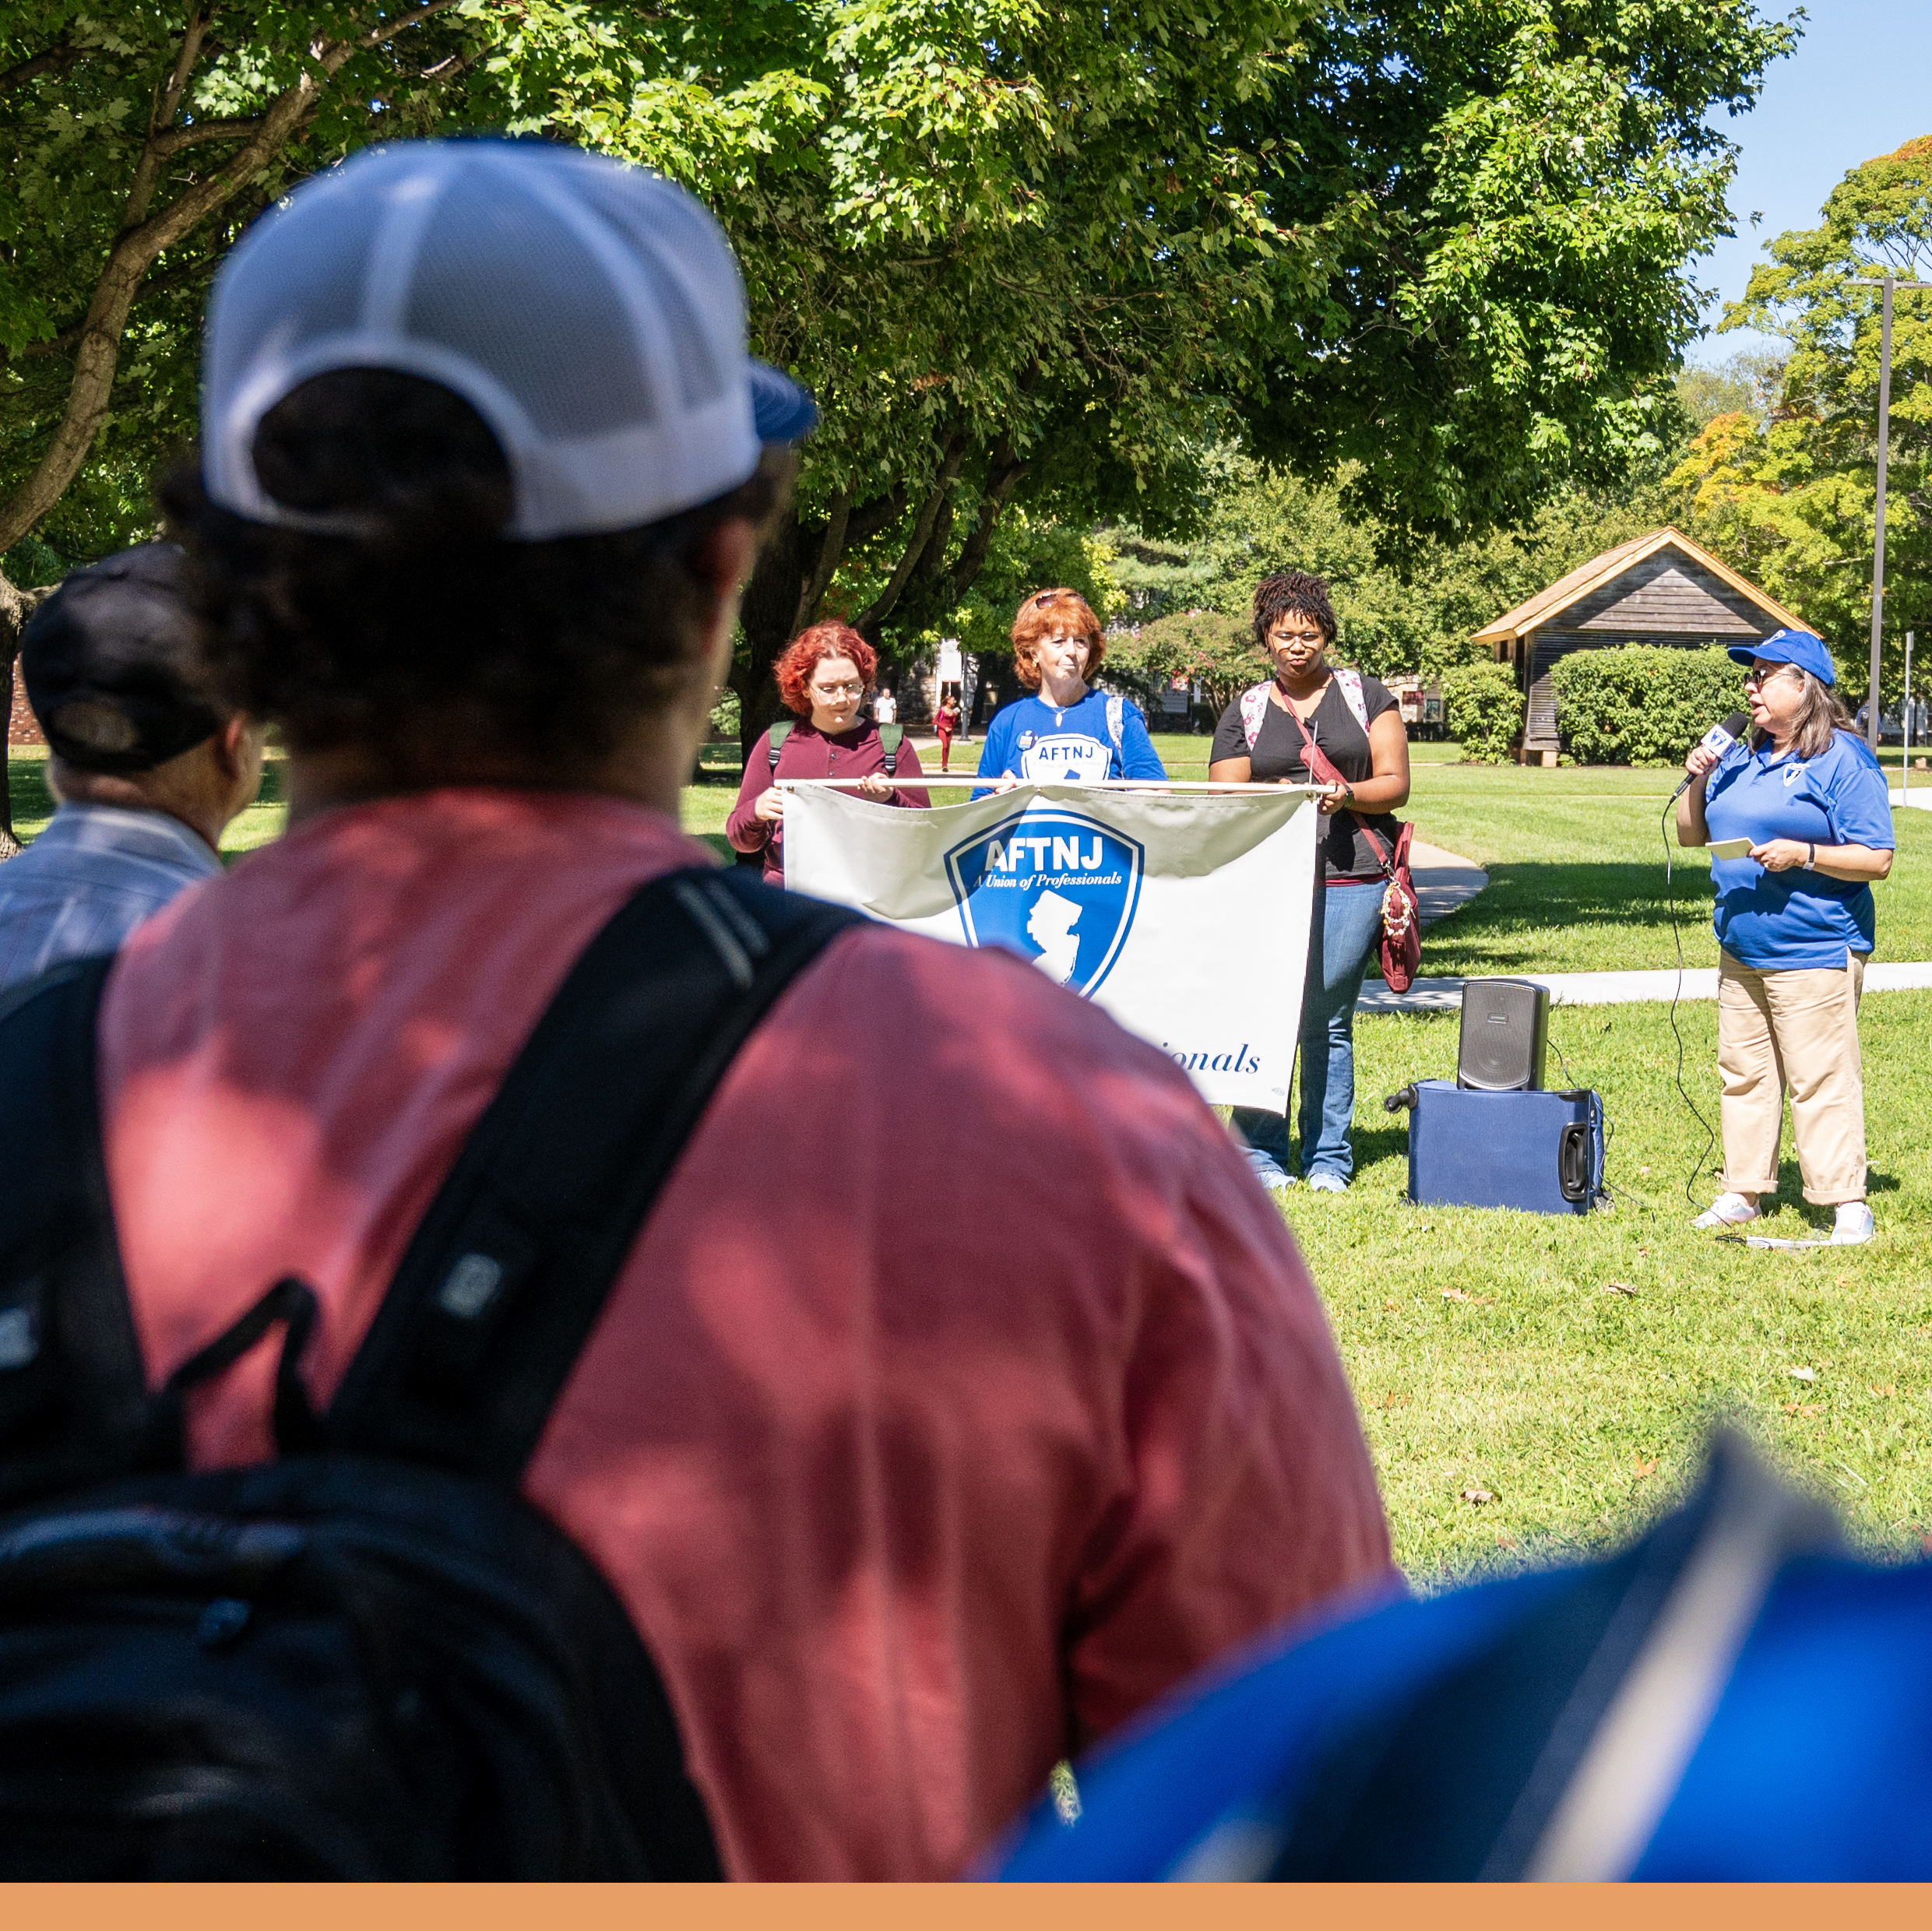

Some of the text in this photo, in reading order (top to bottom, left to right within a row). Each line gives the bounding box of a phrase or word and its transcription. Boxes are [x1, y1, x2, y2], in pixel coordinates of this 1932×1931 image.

[1039, 746, 1093, 761] AFTNJ
[984, 835, 1103, 872] AFTNJ
[973, 871, 1122, 891] A Union of Professionals
[1163, 1042, 1261, 1075] onals
